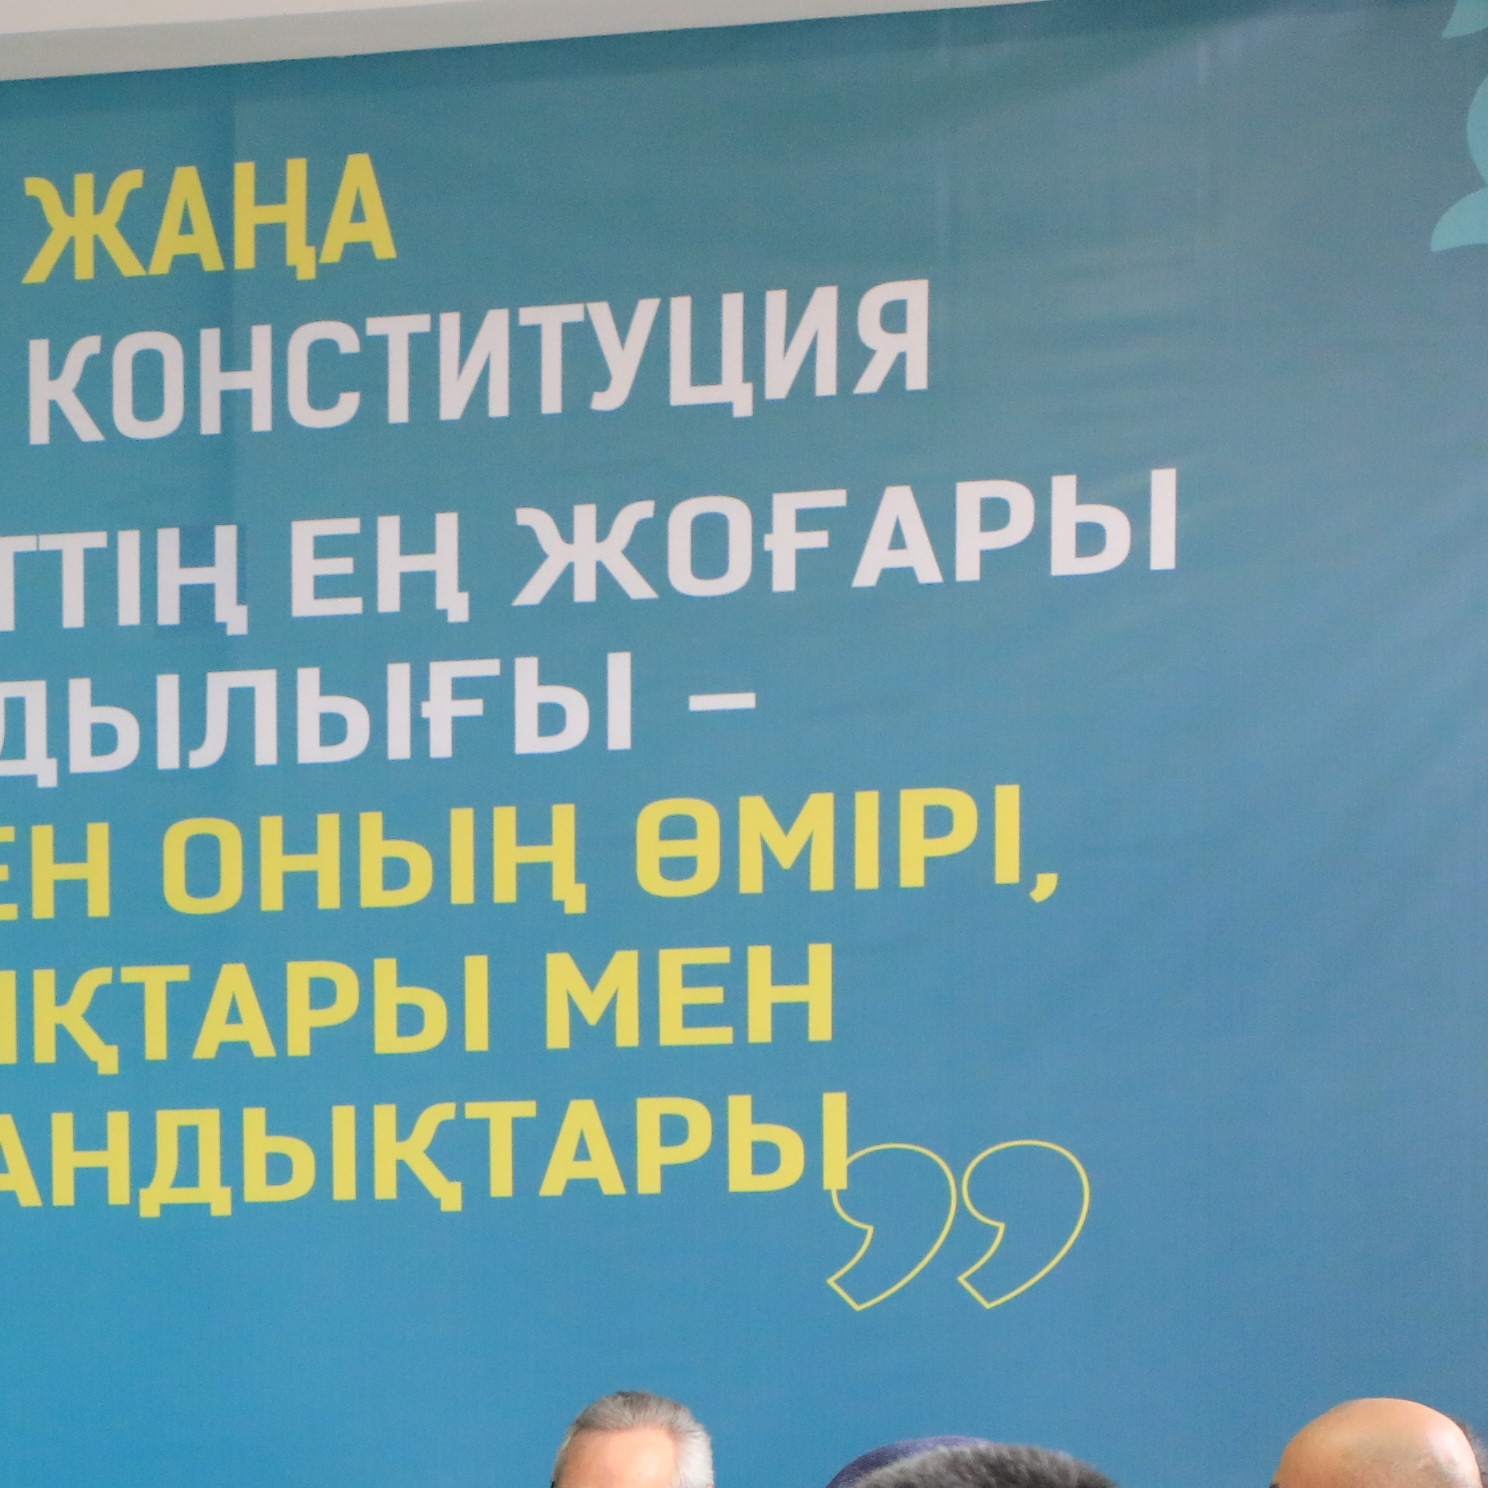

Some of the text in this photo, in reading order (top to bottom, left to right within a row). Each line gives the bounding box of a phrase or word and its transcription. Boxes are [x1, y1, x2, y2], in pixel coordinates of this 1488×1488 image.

[23, 153, 396, 282] ЖАҢА
[28, 278, 930, 445] КОНСТИТУЦИЯ
[290, 511, 470, 623] ЕҢ
[513, 467, 1177, 606] ЖОҒАРЫ
[162, 804, 586, 914] ОНЫҢ
[635, 784, 1058, 902] ӨМІРІ,
[545, 943, 833, 1050] МЕН
